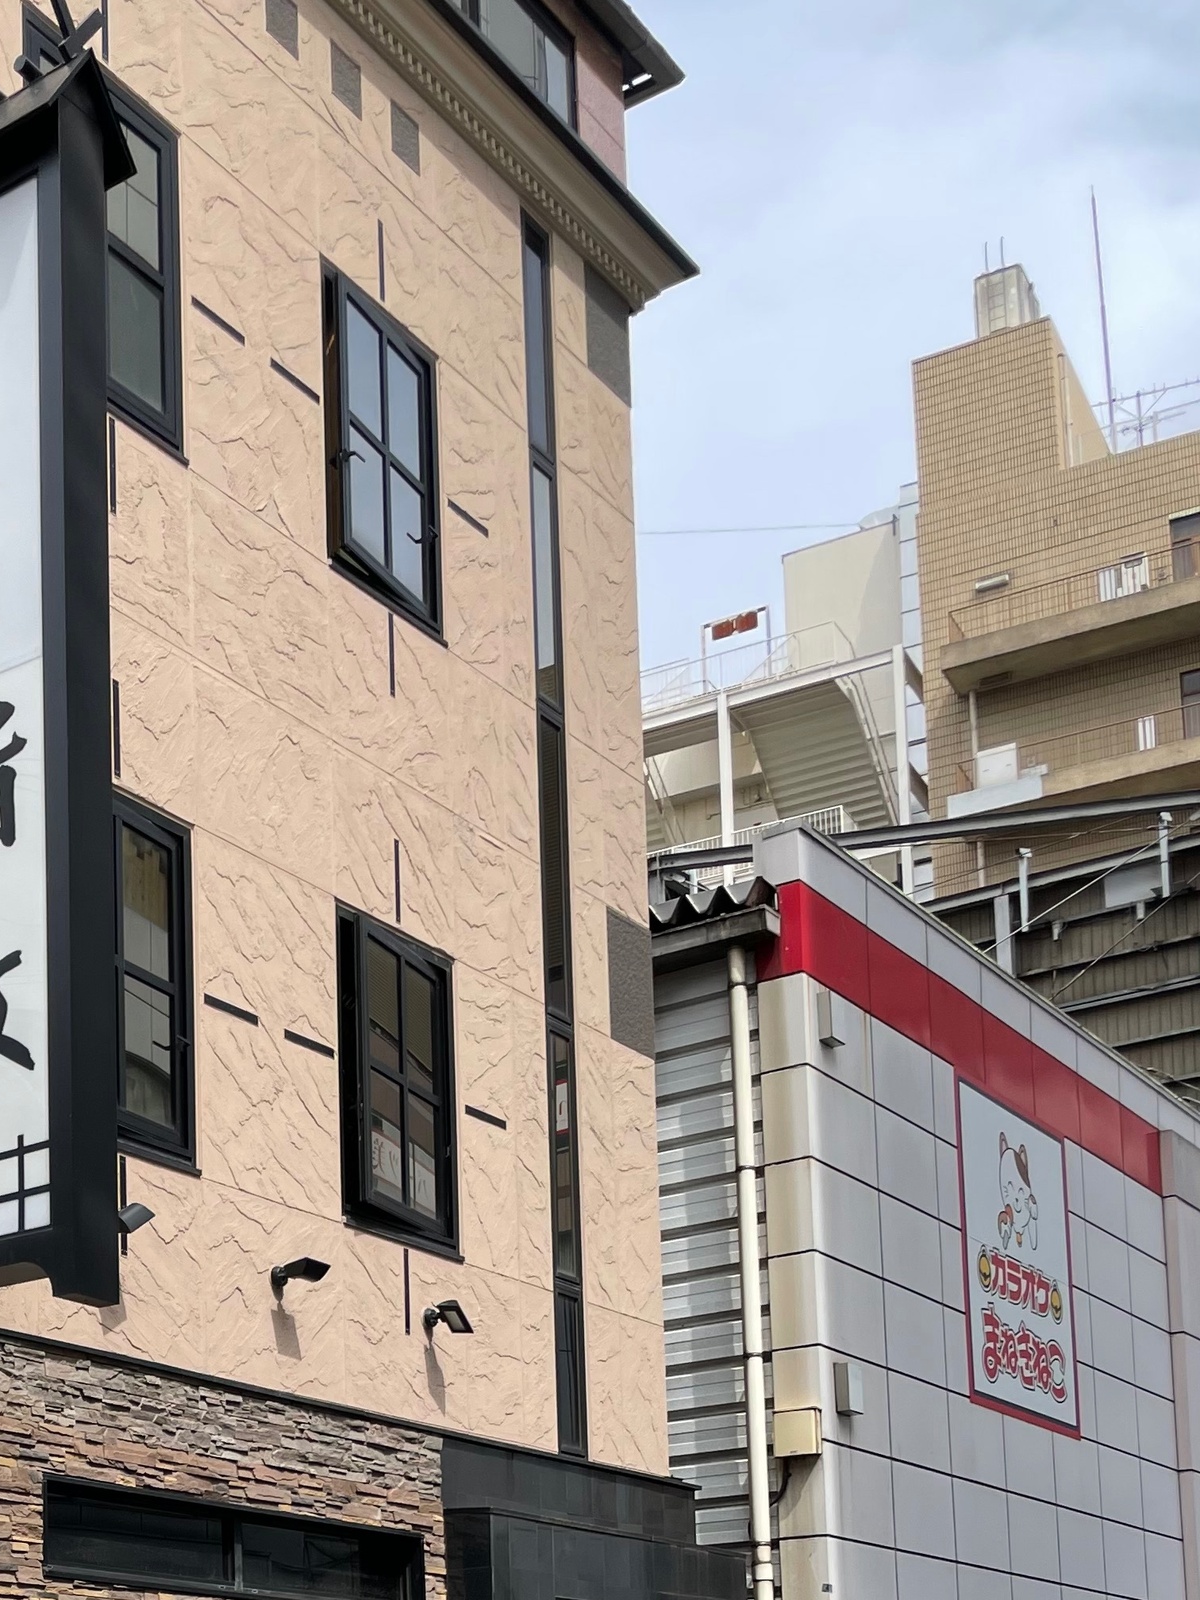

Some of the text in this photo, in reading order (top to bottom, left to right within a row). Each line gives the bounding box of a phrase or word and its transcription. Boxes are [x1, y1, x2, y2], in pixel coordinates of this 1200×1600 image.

[989, 1249, 1051, 1319] カラオケ
[981, 1301, 1068, 1403] まねきねこ
